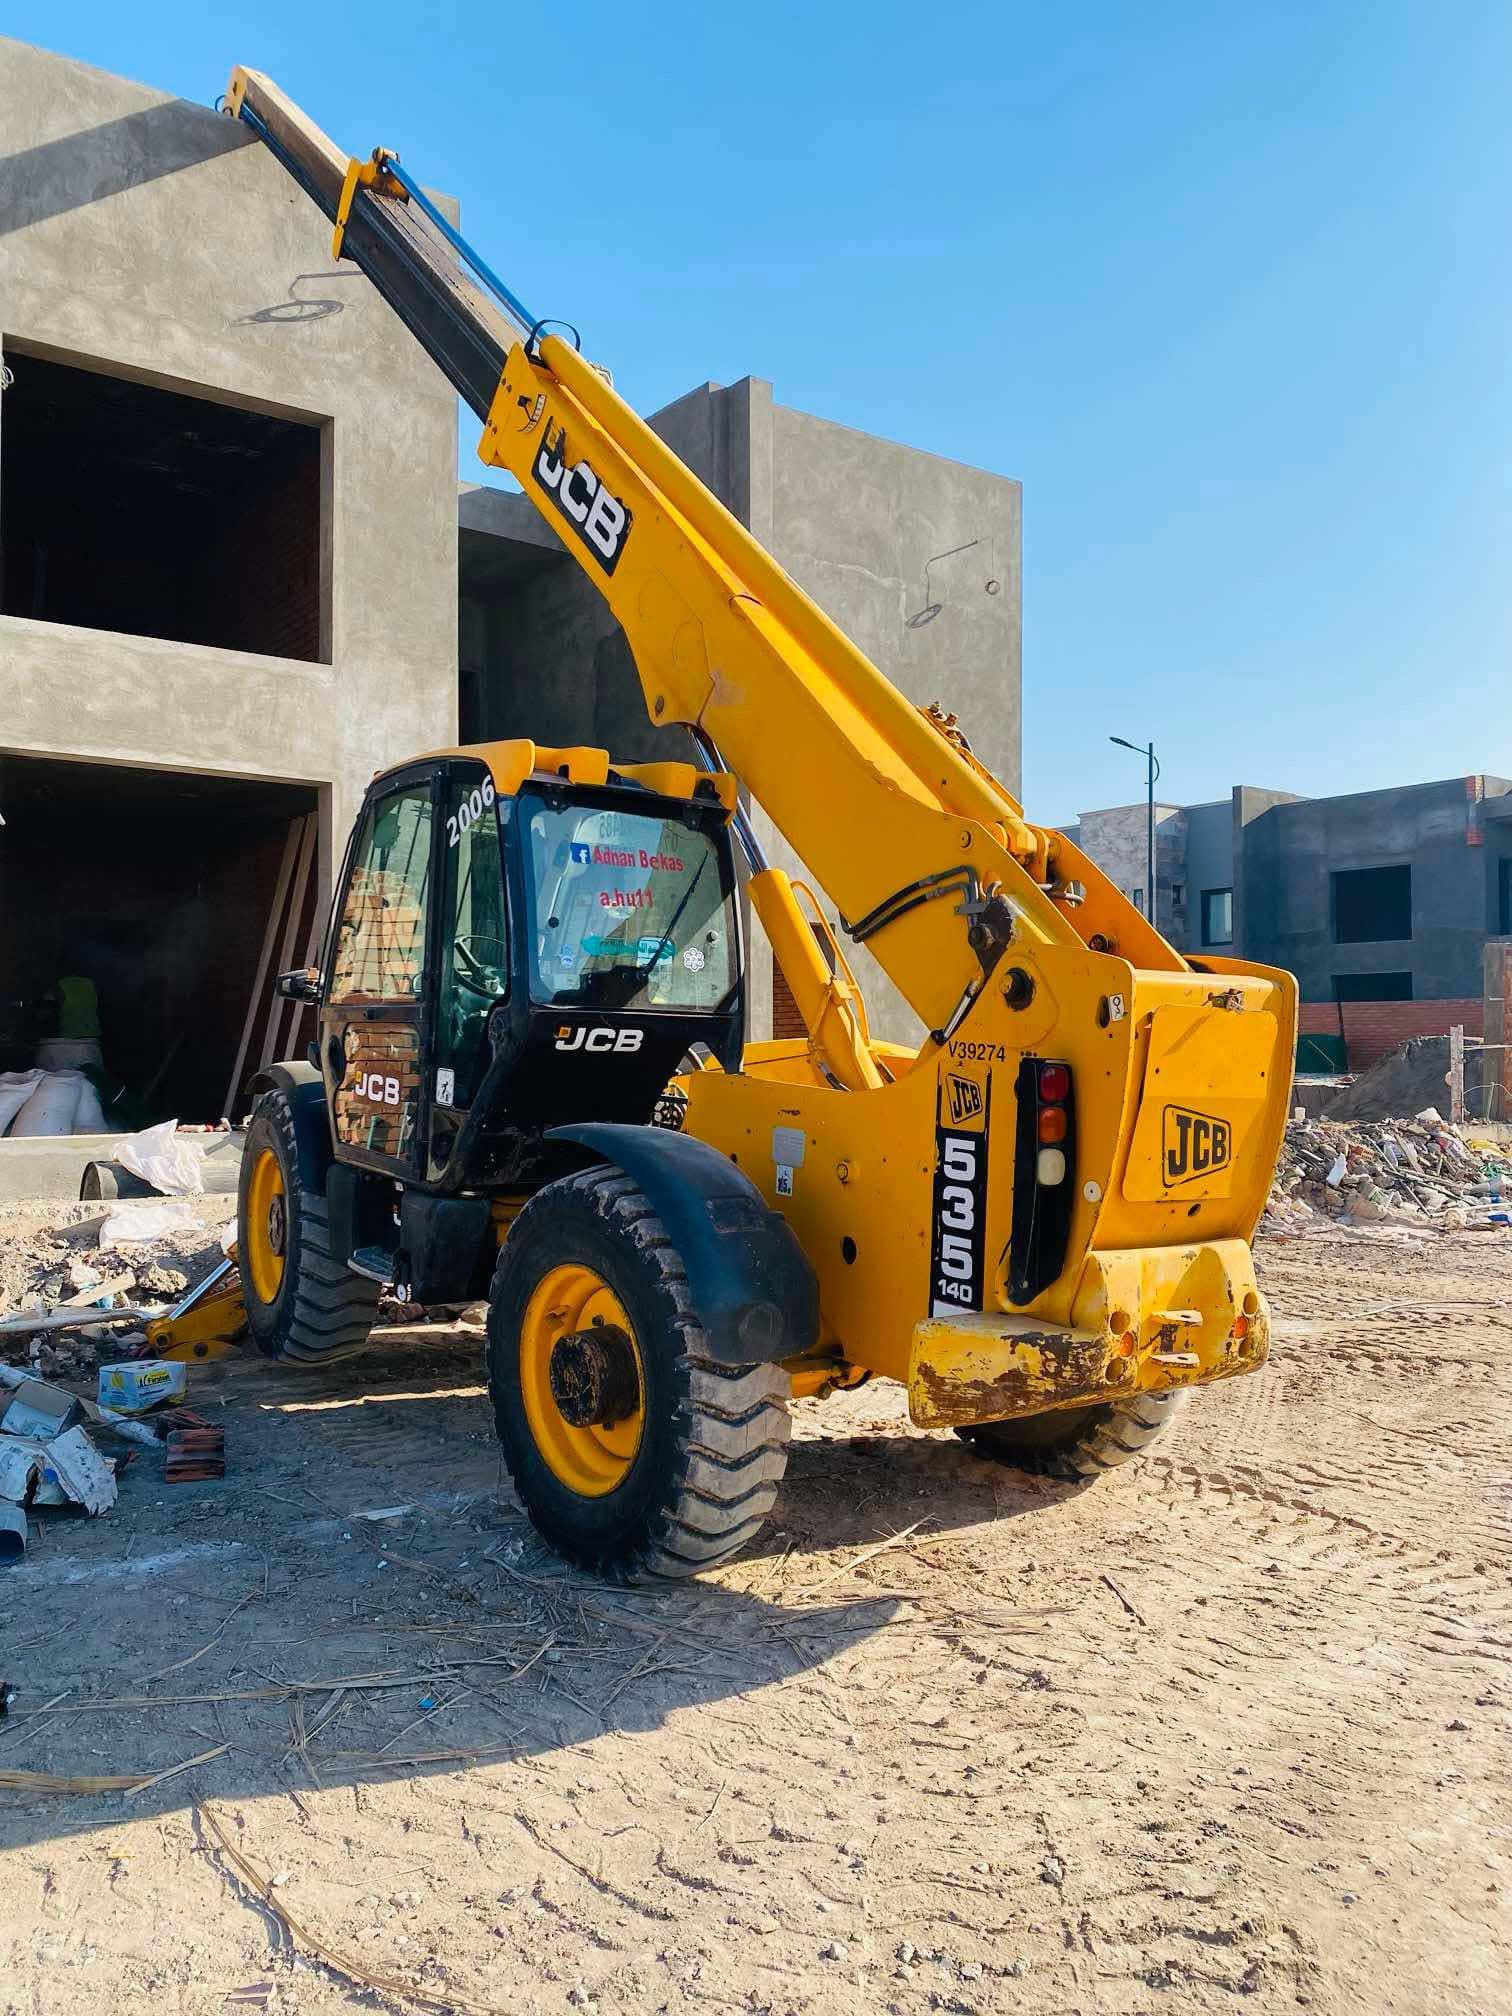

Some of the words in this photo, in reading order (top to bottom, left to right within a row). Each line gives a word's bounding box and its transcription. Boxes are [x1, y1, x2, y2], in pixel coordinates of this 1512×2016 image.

[447, 775, 495, 848] 2006
[593, 846, 636, 867] Adnan
[639, 849, 684, 872] Bekas
[555, 1027, 644, 1051] JCB
[949, 1041, 1006, 1062] V39274
[355, 1072, 400, 1105] JCB
[953, 1079, 980, 1118] JCB
[1168, 1114, 1226, 1176] JCB
[941, 1137, 976, 1280] 535
[938, 1279, 973, 1303] 140
